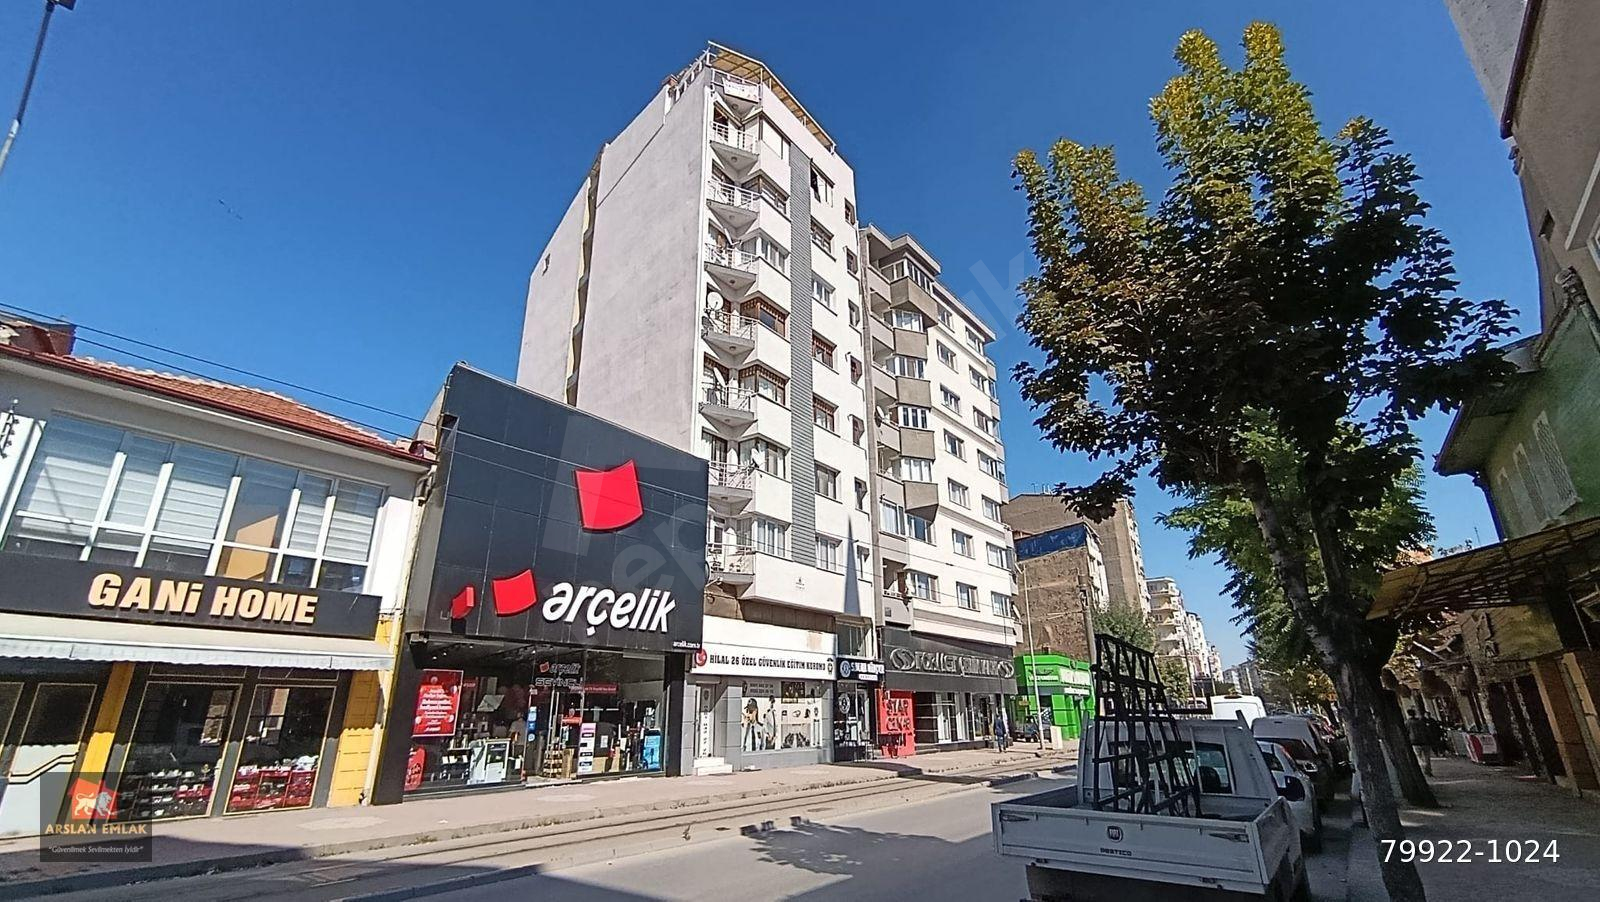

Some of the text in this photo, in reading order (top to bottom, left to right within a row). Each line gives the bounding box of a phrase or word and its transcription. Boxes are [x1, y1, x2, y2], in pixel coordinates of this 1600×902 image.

[210, 586, 318, 625] HOME
[542, 581, 675, 636] arçelik
[731, 656, 739, 665] 26
[742, 654, 756, 666] ÖZEL
